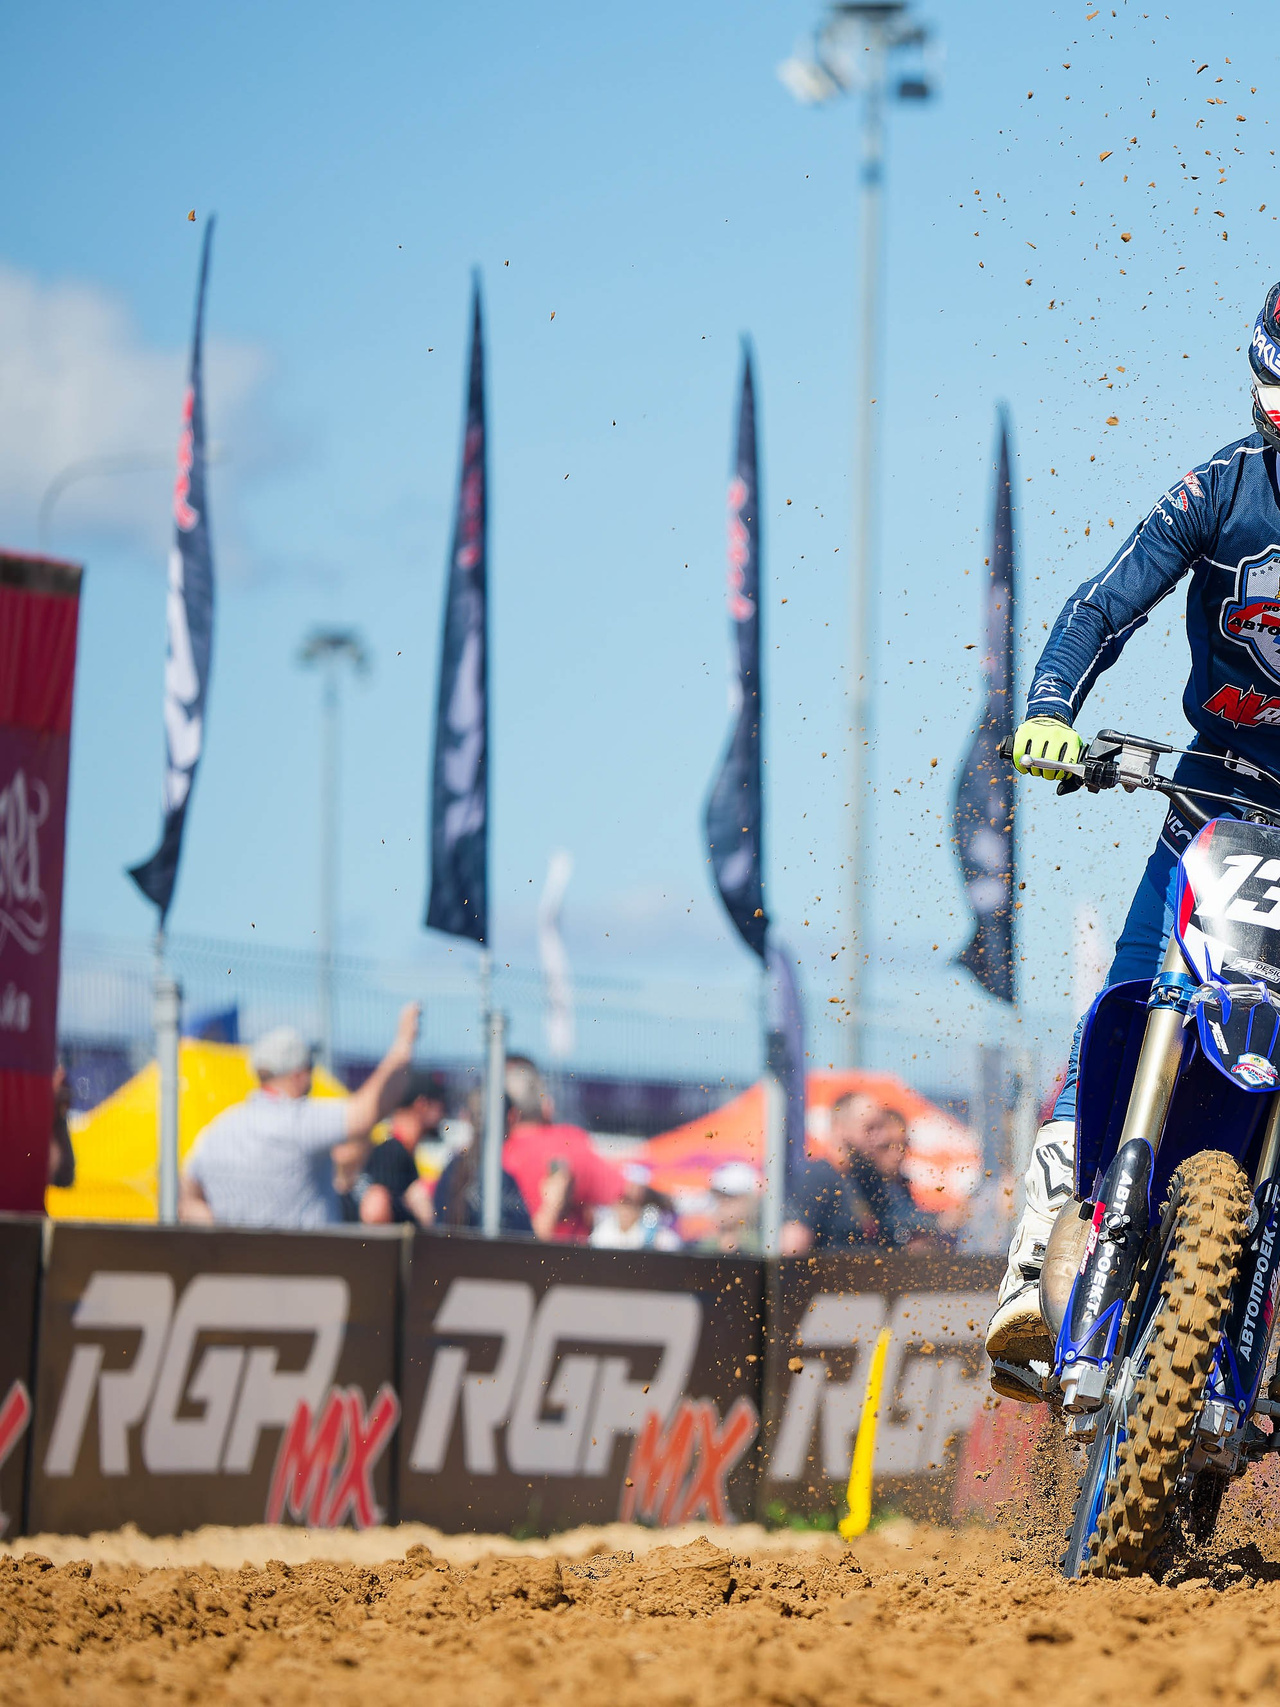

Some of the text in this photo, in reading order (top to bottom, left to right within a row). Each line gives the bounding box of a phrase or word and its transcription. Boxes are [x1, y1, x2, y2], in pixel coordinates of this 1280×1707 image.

[1086, 1169, 1133, 1316] АВТРОЕКТ
[1239, 1220, 1278, 1363] АВТОПРОЕК
[45, 1272, 347, 1477] RGP
[267, 1380, 397, 1528] MX
[410, 1277, 702, 1476] RGP
[620, 1393, 758, 1526] MX
